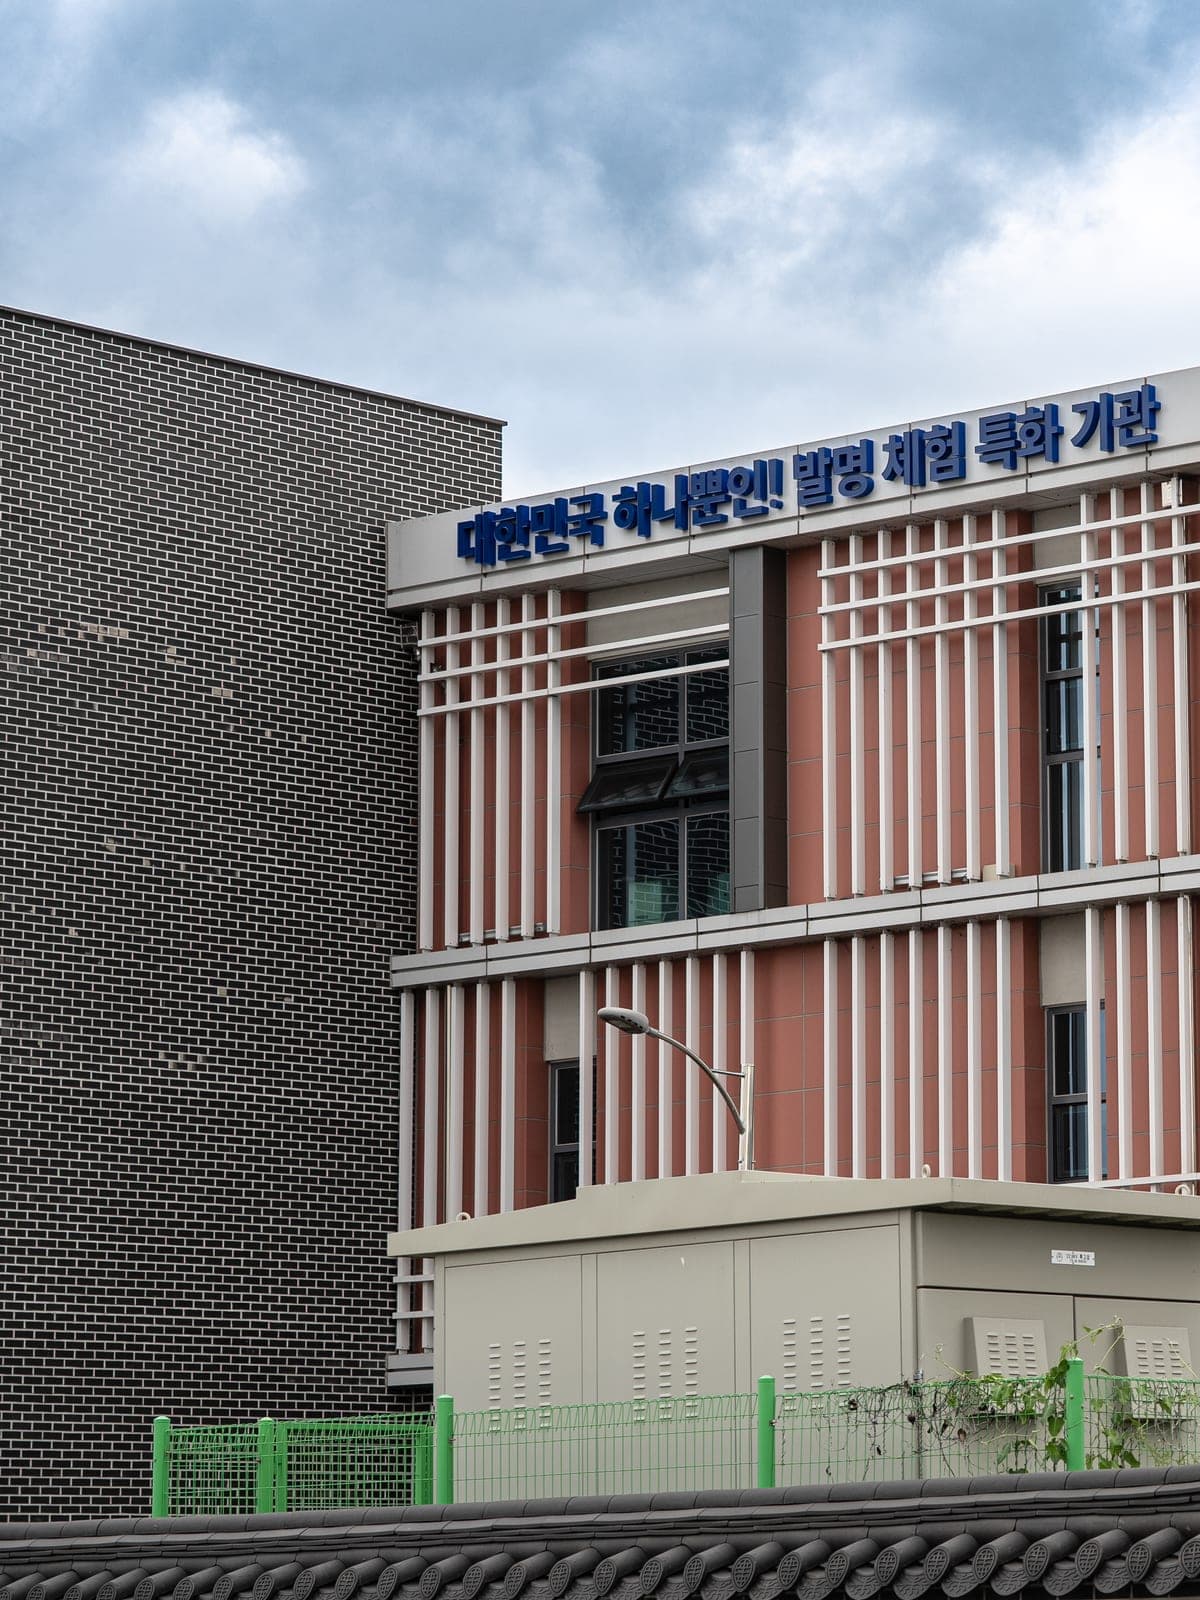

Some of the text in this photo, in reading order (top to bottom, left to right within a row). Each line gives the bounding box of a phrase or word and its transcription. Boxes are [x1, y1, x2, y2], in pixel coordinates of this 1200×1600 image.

[457, 384, 1161, 566] 대한민국 하나뿐인! 발명 체험 특화 기관
